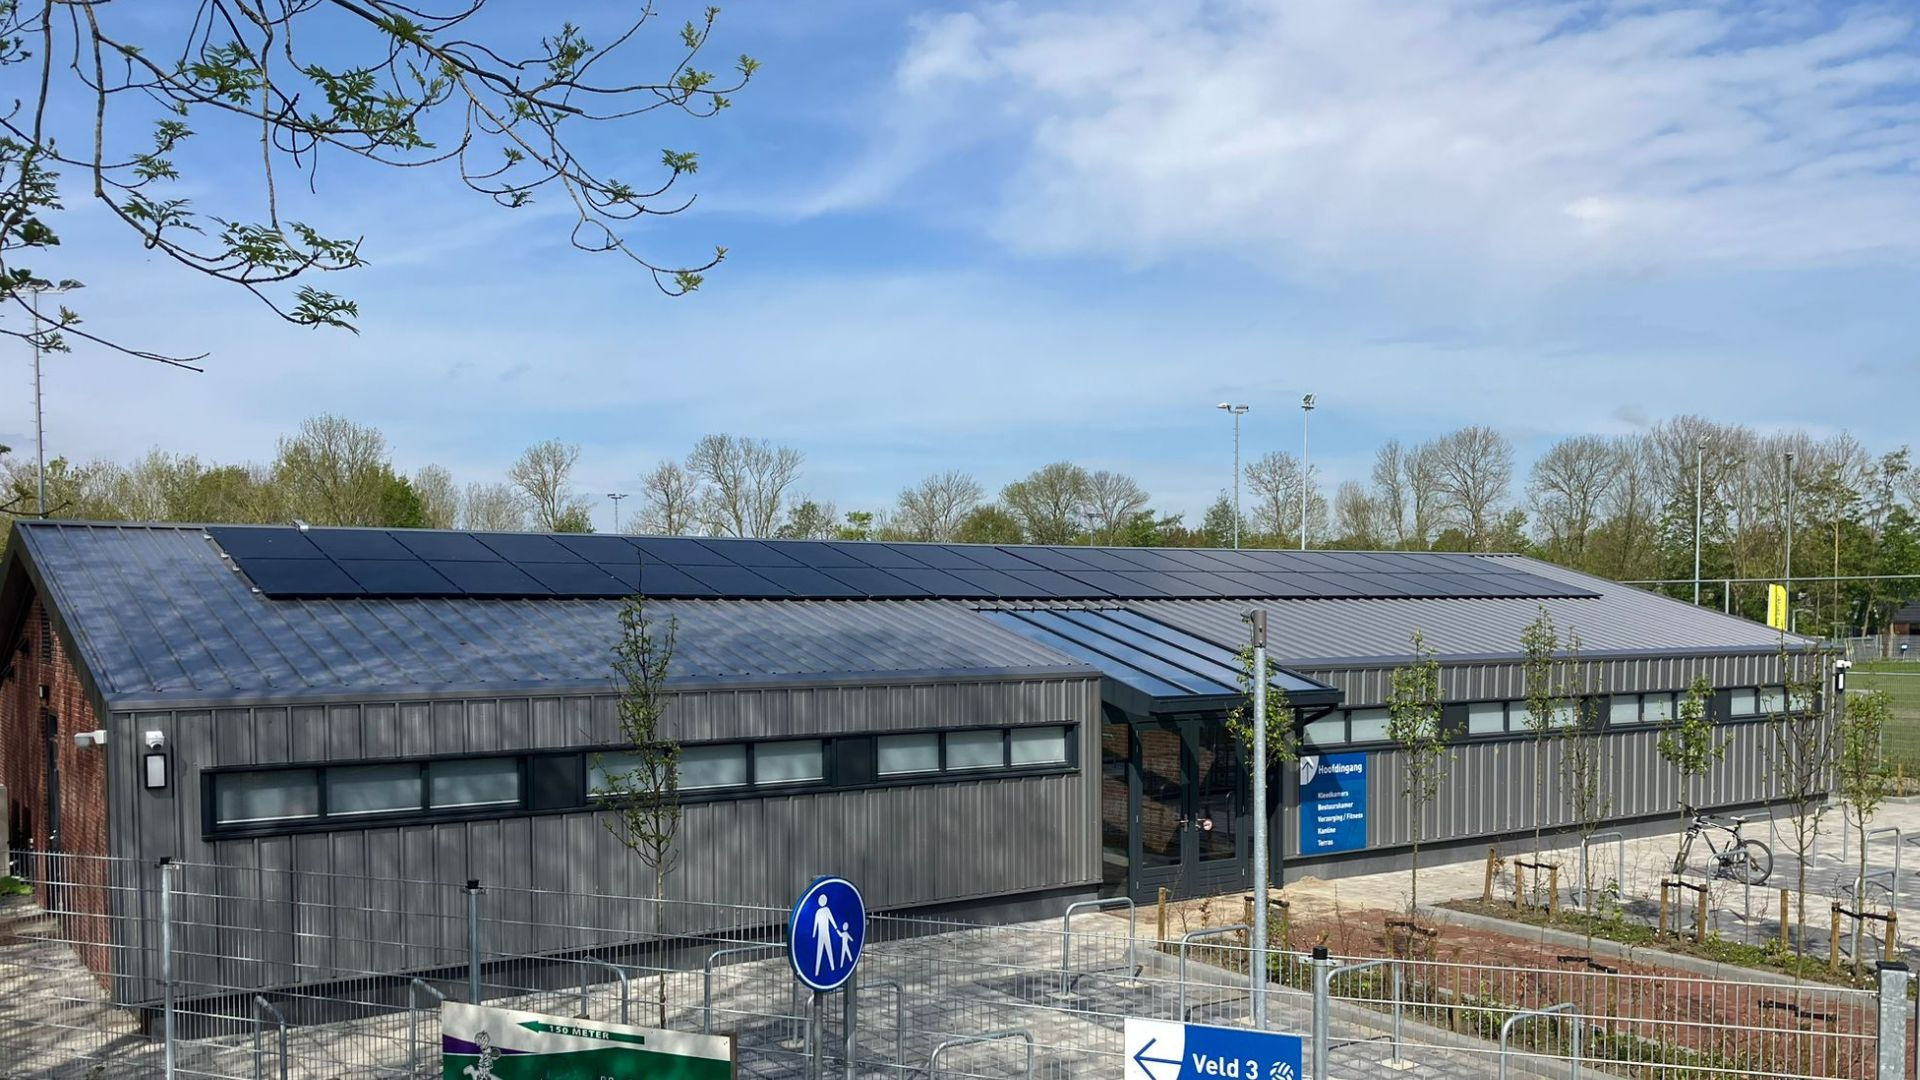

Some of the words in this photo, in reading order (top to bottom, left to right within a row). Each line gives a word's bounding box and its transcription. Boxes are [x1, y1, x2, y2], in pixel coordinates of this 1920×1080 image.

[1319, 764, 1362, 774] Hoofdingang
[1347, 812, 1363, 820] Fitness
[1318, 839, 1334, 847] Terras
[549, 1025, 569, 1034] 150
[572, 1028, 609, 1040] METER
[1192, 1053, 1239, 1078] Veld
[1246, 1060, 1259, 1080] 3
